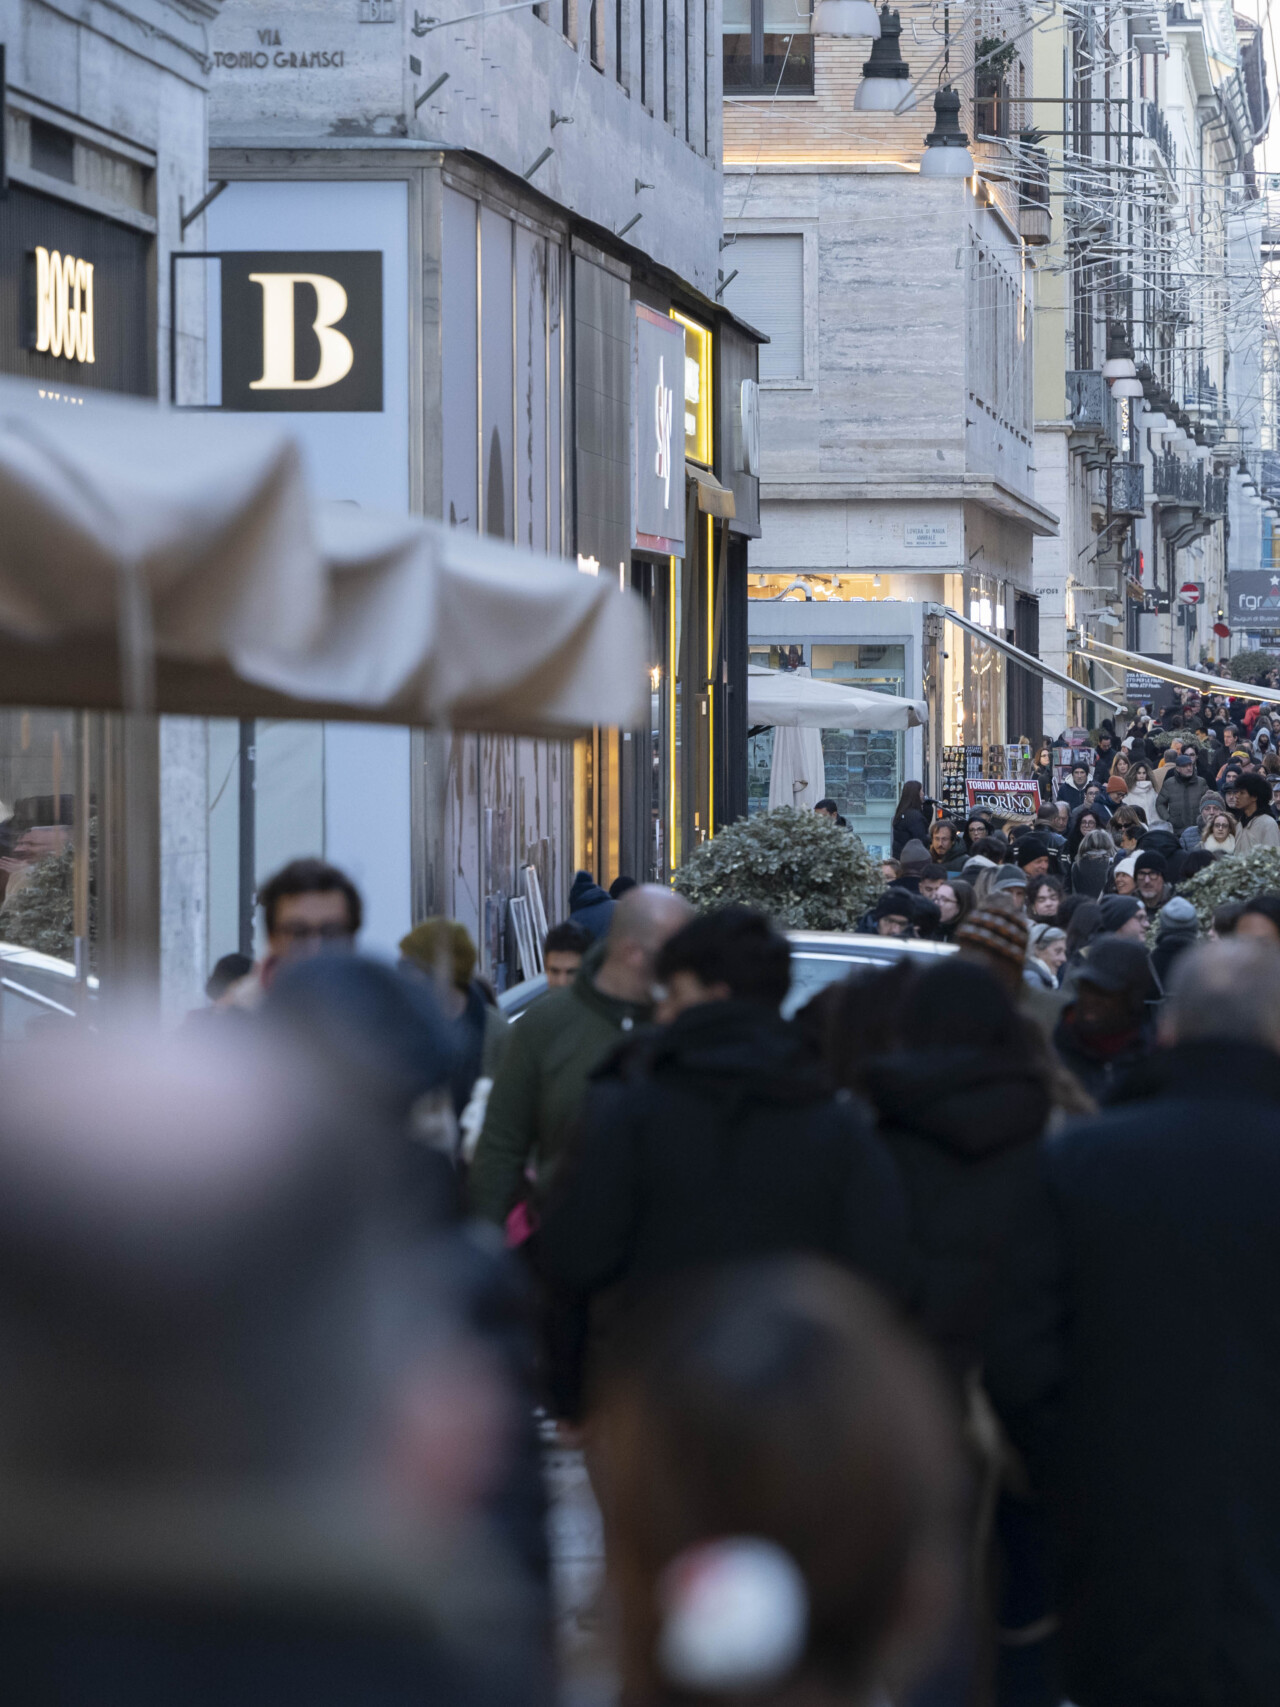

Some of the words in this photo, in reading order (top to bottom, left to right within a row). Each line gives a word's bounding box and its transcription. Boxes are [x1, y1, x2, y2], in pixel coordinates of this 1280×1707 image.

[257, 29, 282, 46] VIA
[214, 52, 269, 69] TONIO
[273, 51, 344, 69] GRAMSCI
[35, 246, 95, 364] BOGGI
[249, 272, 354, 390] B
[1239, 594, 1263, 611] fgr
[968, 781, 995, 790] TORINO
[997, 782, 1037, 790] MAGAZINE
[977, 794, 1032, 809] TORINO
